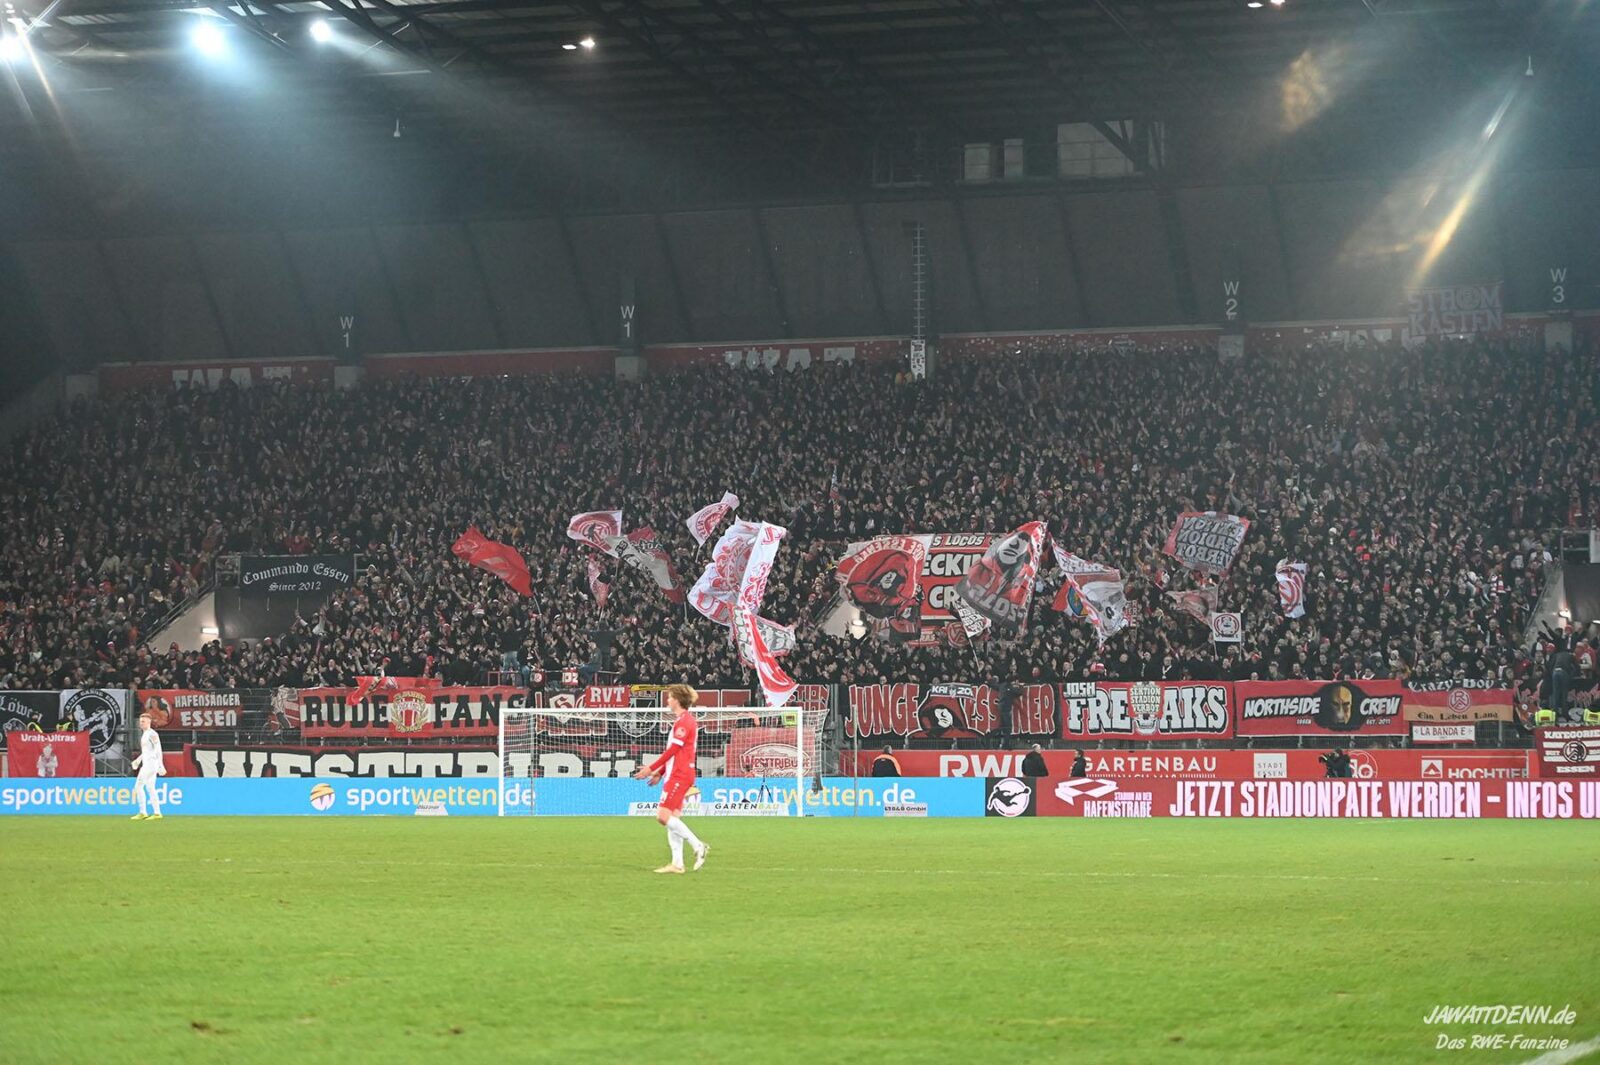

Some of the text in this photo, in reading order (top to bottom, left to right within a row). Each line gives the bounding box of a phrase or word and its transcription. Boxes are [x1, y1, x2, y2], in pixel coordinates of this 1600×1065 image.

[1550, 268, 1567, 282] W
[1223, 281, 1240, 296] W
[1553, 285, 1564, 303] 3
[621, 305, 635, 320] W
[1225, 298, 1239, 316] 2
[339, 316, 354, 330] W
[624, 321, 632, 338] 1
[242, 562, 350, 585] Commando Essen
[268, 581, 322, 592] Since 2012
[590, 687, 625, 703] RVT
[931, 685, 948, 694] KAI
[1063, 682, 1097, 699] JOSH
[65, 694, 79, 711] ALTE
[174, 692, 241, 708] HAFENSÄNGER
[1130, 696, 1161, 705] STADION
[1243, 697, 1401, 719] NORTHSIDE CREW
[303, 695, 390, 729] RUDE
[844, 683, 922, 739] JUNGE
[1132, 705, 1160, 713] VERBOT
[181, 711, 237, 728] ESSEN
[20, 732, 77, 743] Uralt-Ultras
[1419, 727, 1431, 737] LA
[1432, 726, 1458, 736] BANDA
[1084, 756, 1217, 772] GARTENBAU
[1257, 762, 1284, 770] STADT
[1257, 770, 1284, 778] ESSEN
[1169, 781, 1235, 817] JETZT
[1240, 781, 1383, 818] STADIONPATE
[1388, 781, 1481, 818] WERDEN
[1506, 782, 1573, 818] INFOS
